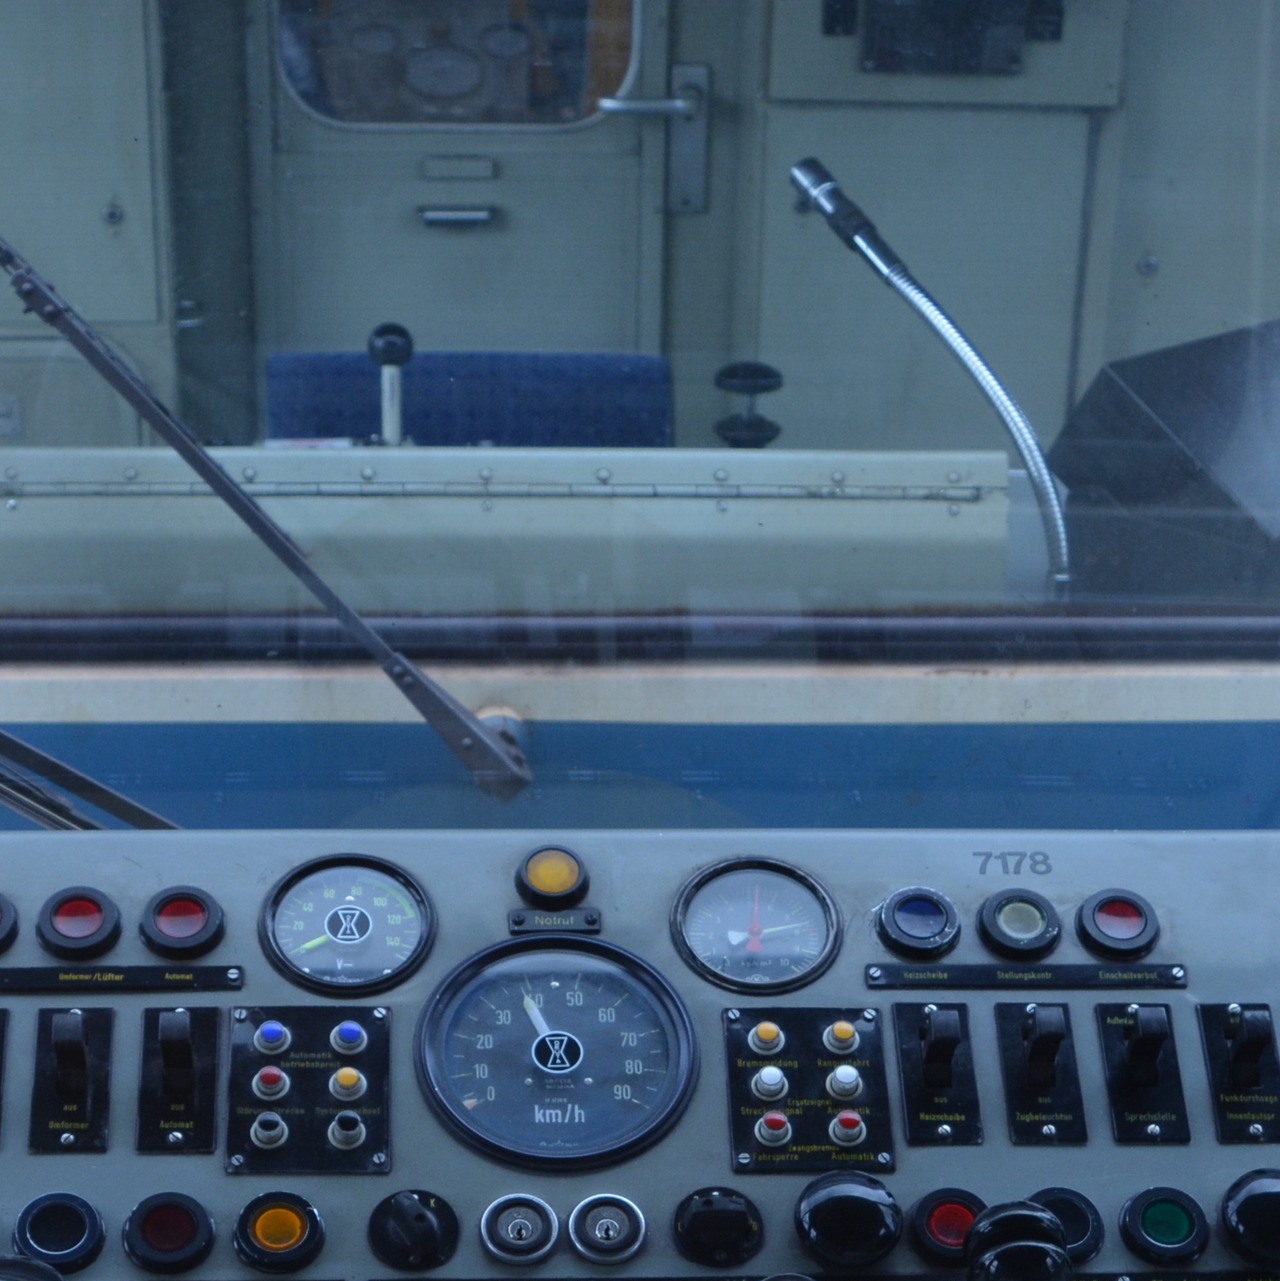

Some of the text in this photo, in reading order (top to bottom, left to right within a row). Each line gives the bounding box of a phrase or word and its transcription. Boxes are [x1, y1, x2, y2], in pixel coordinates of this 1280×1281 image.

[972, 851, 1053, 876] 7178
[323, 888, 336, 898] 60
[350, 886, 363, 896] 80
[302, 902, 314, 912] 40
[372, 896, 388, 907] 100
[292, 921, 304, 931] 20
[387, 914, 402, 925] 120
[534, 915, 575, 926] Notruf
[385, 936, 401, 947] 140
[566, 991, 583, 1006] 50
[495, 1009, 511, 1025] 30
[597, 1008, 616, 1023] 60
[475, 1034, 493, 1050] 20
[620, 1032, 638, 1047] 70
[473, 1063, 489, 1078] 10
[624, 1060, 643, 1075] 80
[486, 1086, 496, 1100] 0
[613, 1084, 631, 1100] 90
[534, 1103, 586, 1123] km/h
[158, 1119, 196, 1130] Automat
[831, 1152, 876, 1161] Automatik
